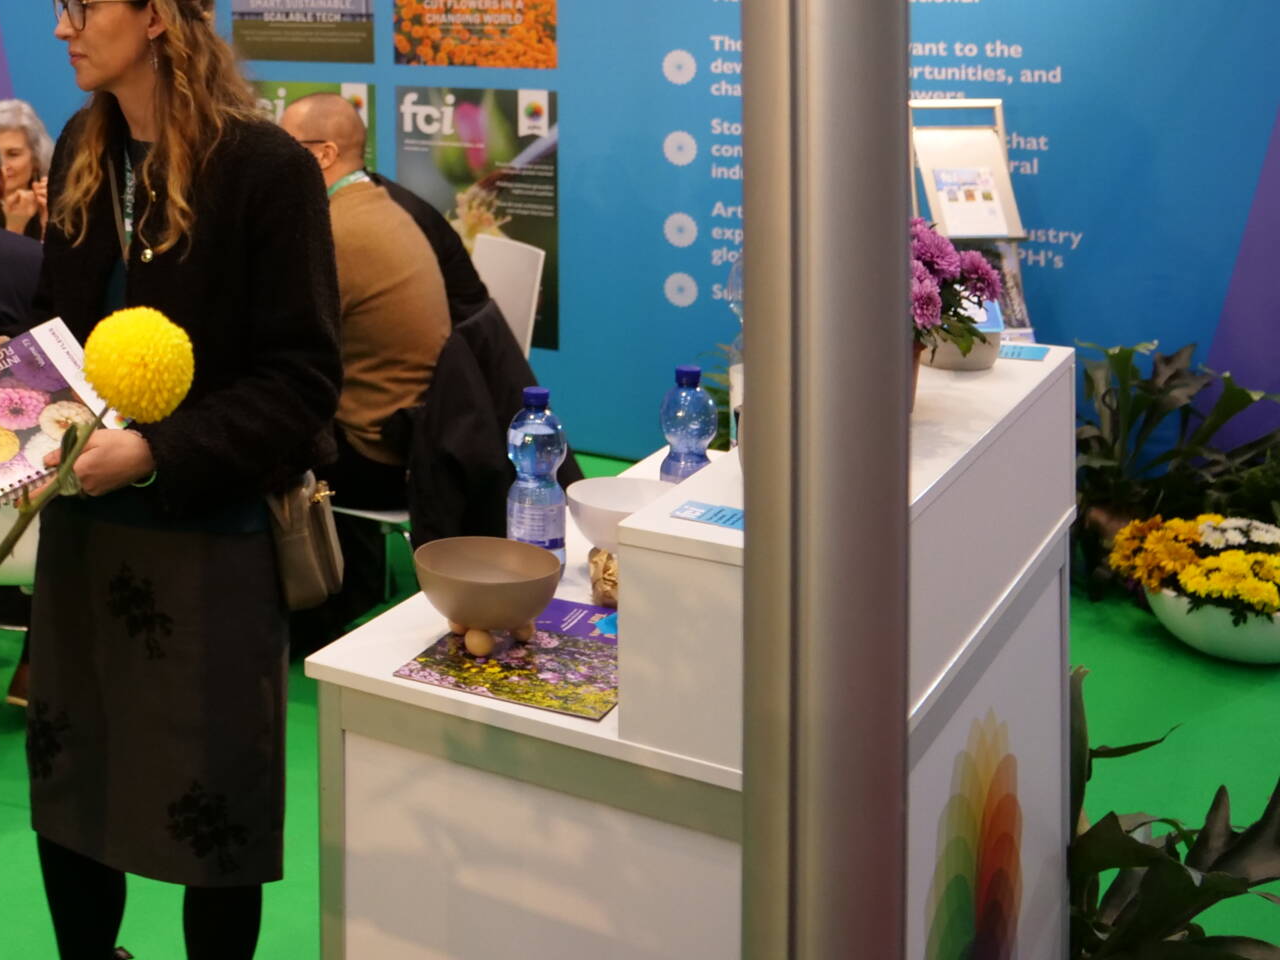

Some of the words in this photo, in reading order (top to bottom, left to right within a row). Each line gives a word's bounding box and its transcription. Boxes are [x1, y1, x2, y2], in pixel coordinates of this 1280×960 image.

[483, 13, 525, 25] WORLD
[954, 42, 978, 57] to
[985, 40, 1023, 58] the
[1020, 67, 1062, 83] and
[399, 91, 456, 136] fci
[711, 162, 744, 180] ind
